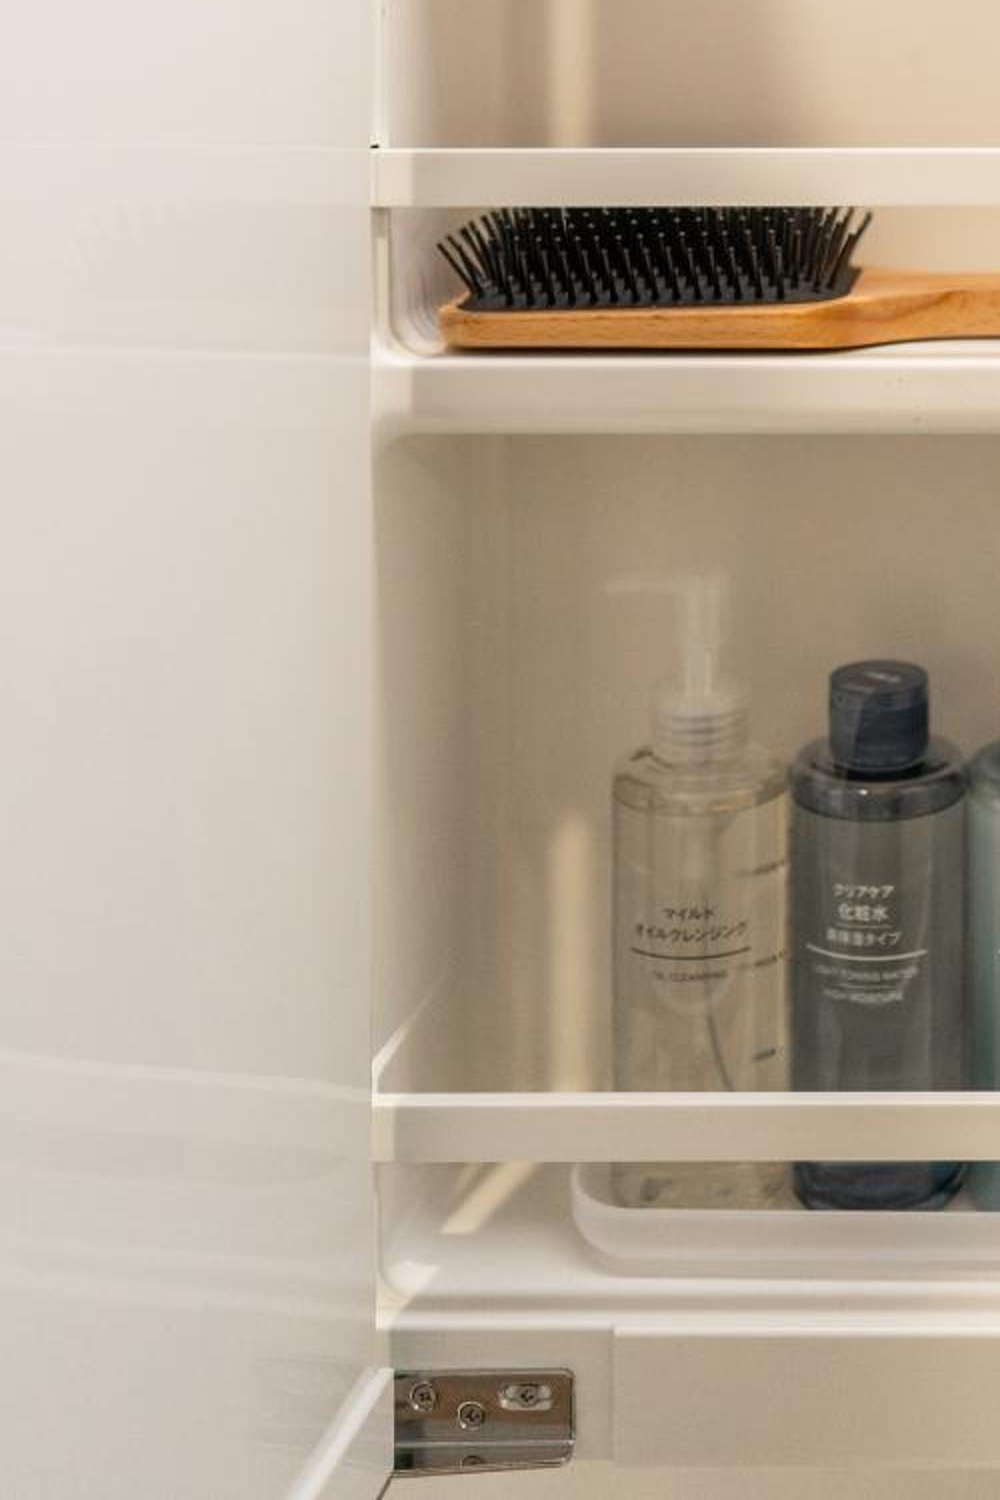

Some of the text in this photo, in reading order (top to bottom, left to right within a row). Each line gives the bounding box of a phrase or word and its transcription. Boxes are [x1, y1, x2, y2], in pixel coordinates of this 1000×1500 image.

[832, 884, 895, 899] クリアケア
[838, 903, 888, 921] 化粧水
